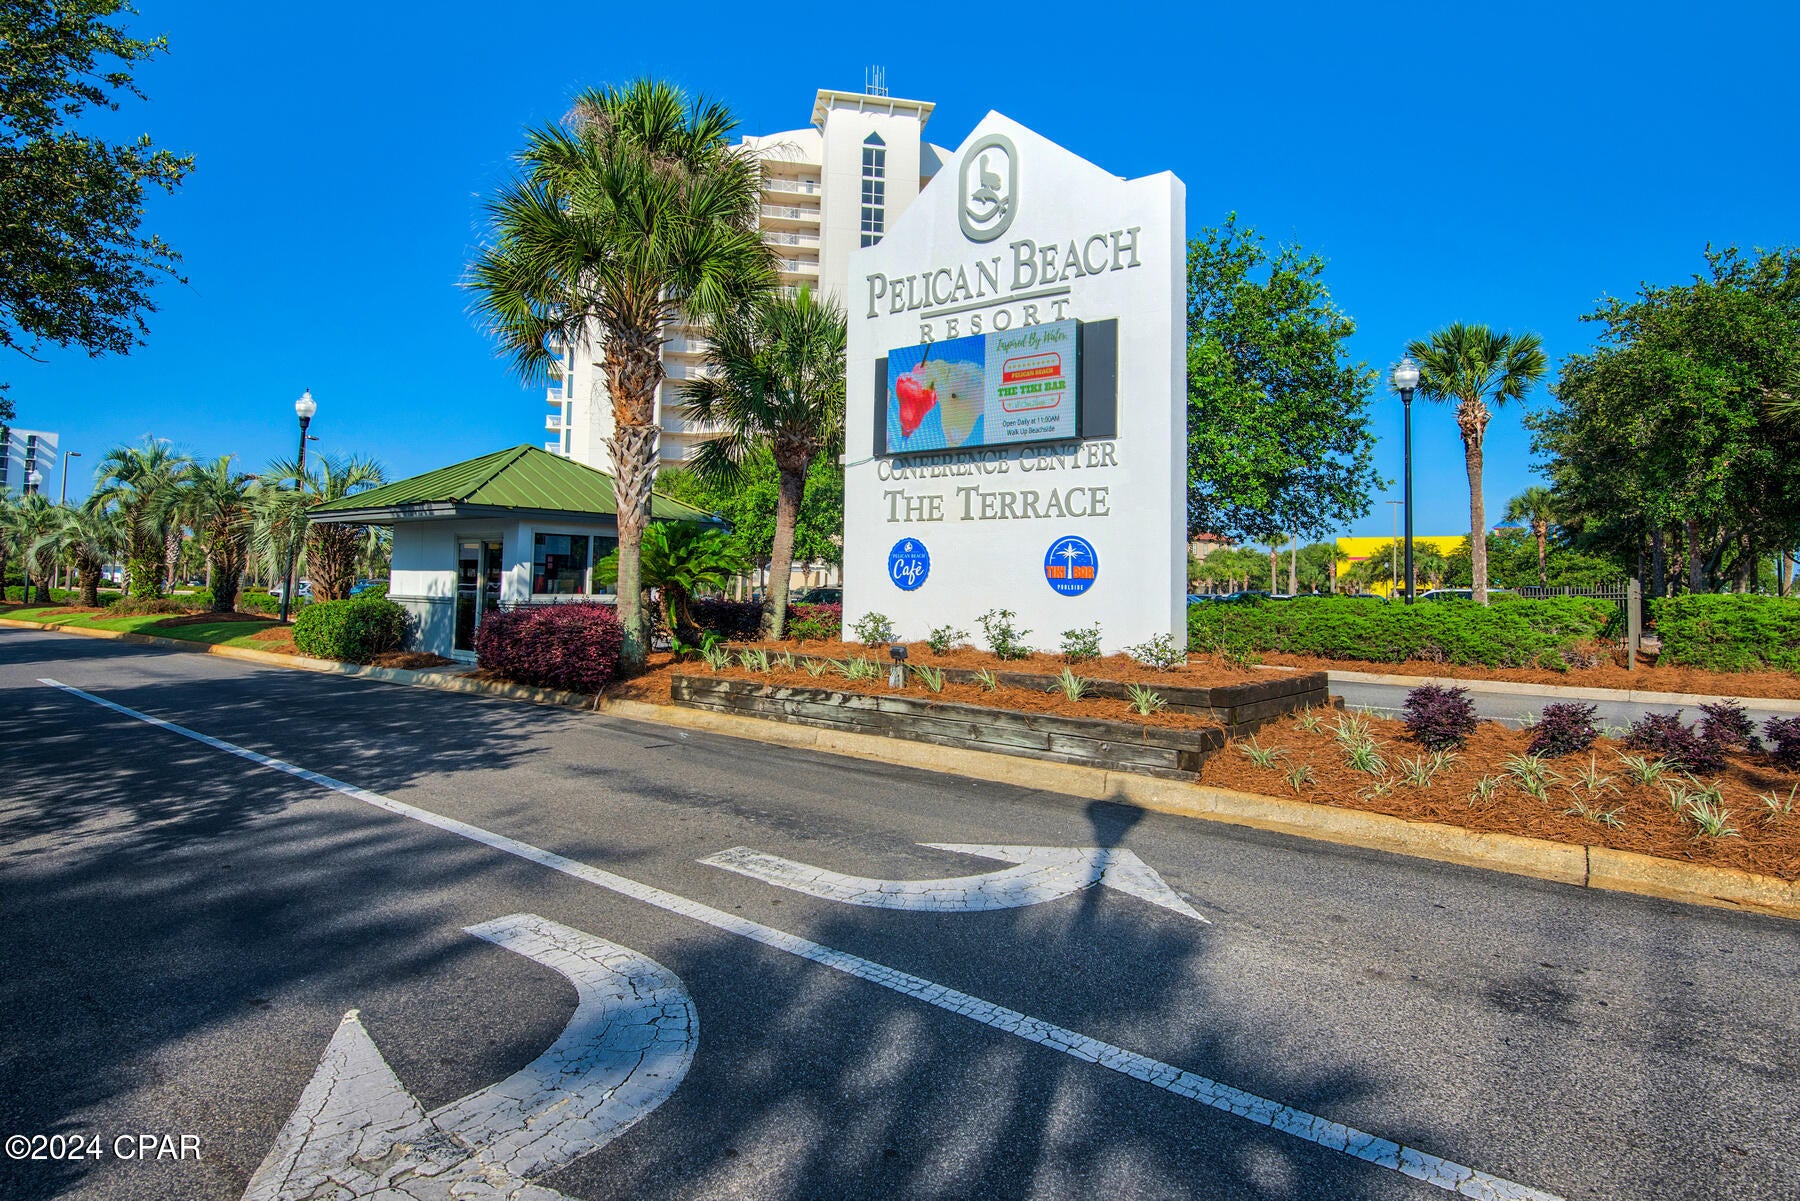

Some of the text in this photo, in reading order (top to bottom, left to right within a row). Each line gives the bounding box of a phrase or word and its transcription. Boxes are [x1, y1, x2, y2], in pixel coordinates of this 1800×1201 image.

[866, 226, 1141, 319] PELICAN BEACH
[920, 298, 1070, 344] RESORT
[1029, 332, 1040, 349] By
[1012, 368, 1053, 378] PELICAN BEACH
[998, 380, 1066, 397] THE TIKI BAR
[1002, 419, 1017, 427] Open
[1017, 417, 1029, 426] Daily
[1037, 414, 1060, 423] 11:00AM
[1007, 425, 1055, 436] Walk Up Beachside
[877, 441, 1119, 481] CONFERENCE CENTER
[883, 484, 1111, 523] THE TERRACE
[1046, 565, 1095, 579] TIKI BAR
